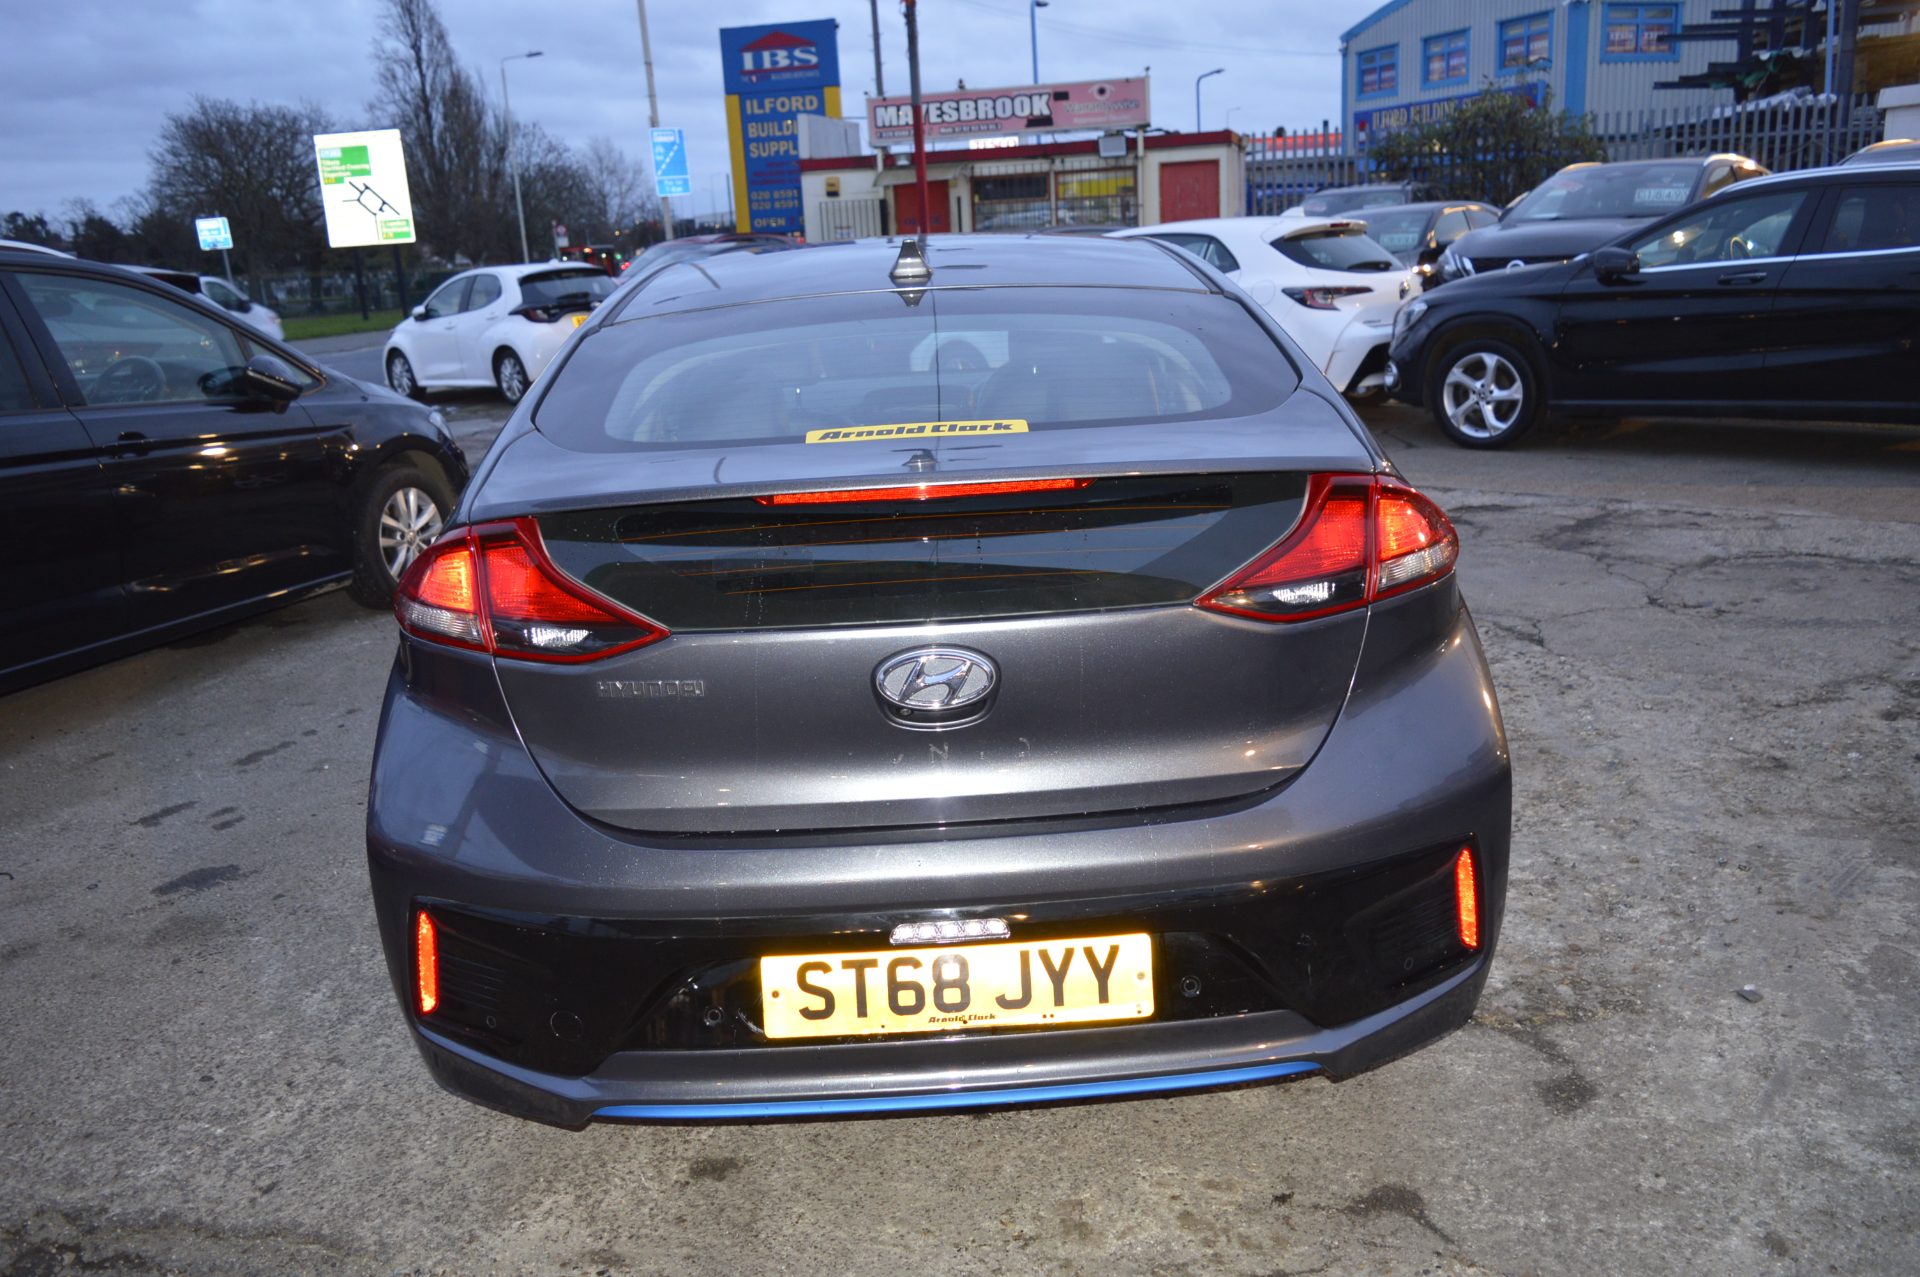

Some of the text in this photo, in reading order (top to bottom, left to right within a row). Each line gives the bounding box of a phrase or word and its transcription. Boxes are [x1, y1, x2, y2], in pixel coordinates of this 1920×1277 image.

[742, 46, 819, 71] IBS
[746, 95, 819, 115] ILFORD
[818, 421, 1014, 441] Arnold Clark
[795, 944, 1120, 1021] ST68 JYY
[968, 1013, 996, 1021] Clark
